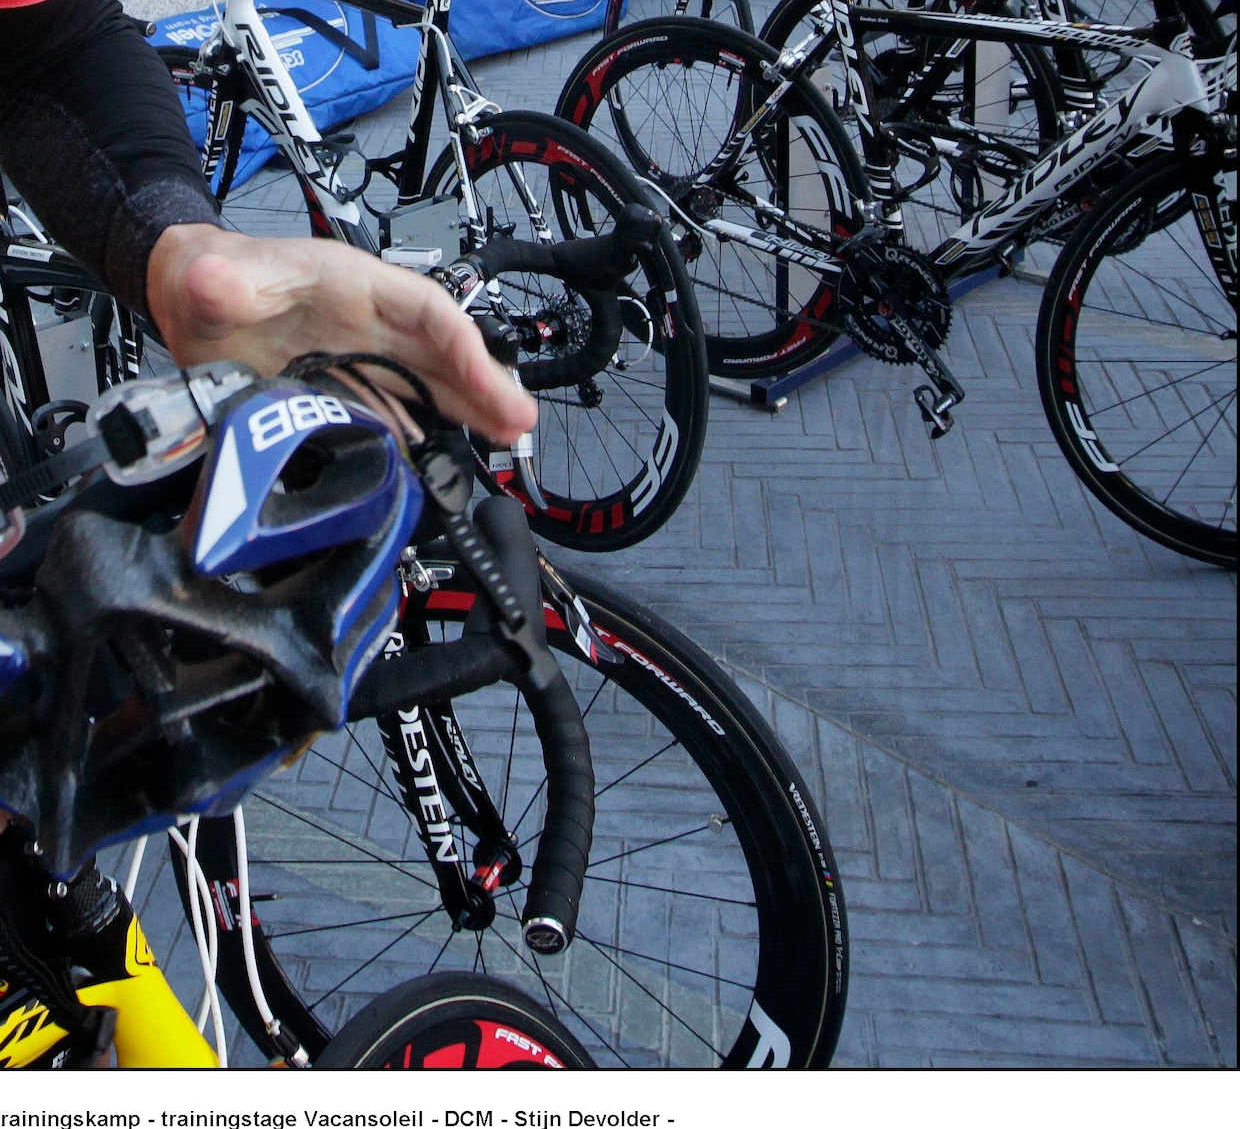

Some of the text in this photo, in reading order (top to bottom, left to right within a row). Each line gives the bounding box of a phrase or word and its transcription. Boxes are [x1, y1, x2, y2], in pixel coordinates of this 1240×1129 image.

[592, 52, 616, 76] FAST
[247, 392, 353, 453] BBB
[614, 641, 726, 736] FORWARD
[788, 781, 822, 850] VREDESTEIN
[494, 1027, 542, 1056] FAST
